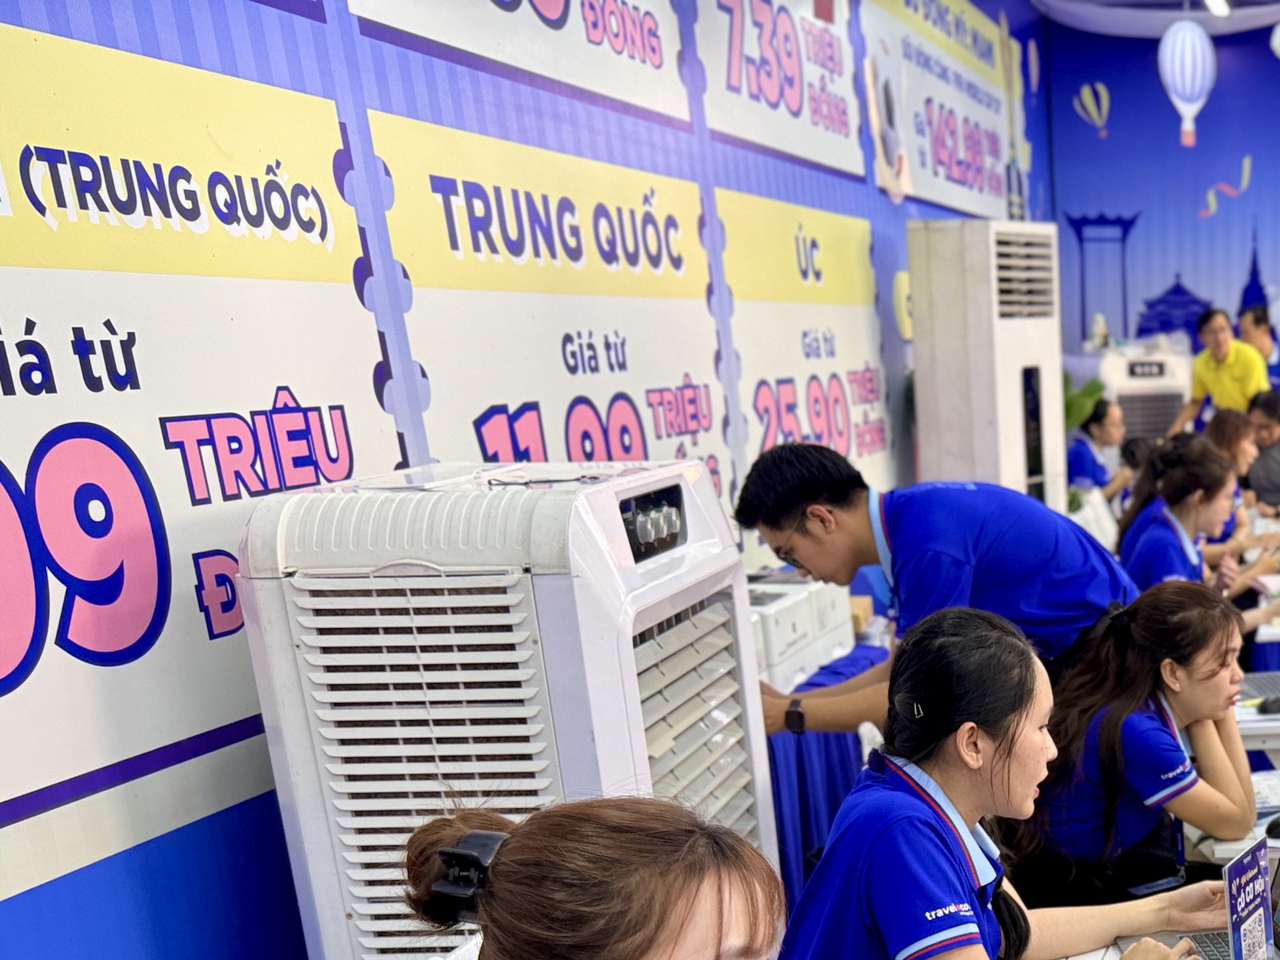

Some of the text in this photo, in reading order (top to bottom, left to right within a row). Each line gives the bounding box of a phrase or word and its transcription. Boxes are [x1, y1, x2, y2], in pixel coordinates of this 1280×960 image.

[716, 0, 803, 119] 7.39
[18, 143, 328, 243] (TRUNG QUỐC)
[429, 174, 684, 271] TRUNG QUỐC
[795, 222, 822, 282] ÚC
[0, 317, 141, 396] iá từ
[562, 330, 628, 375] Giá từ
[802, 328, 822, 360] Giá
[645, 372, 713, 447] TRIỆU
